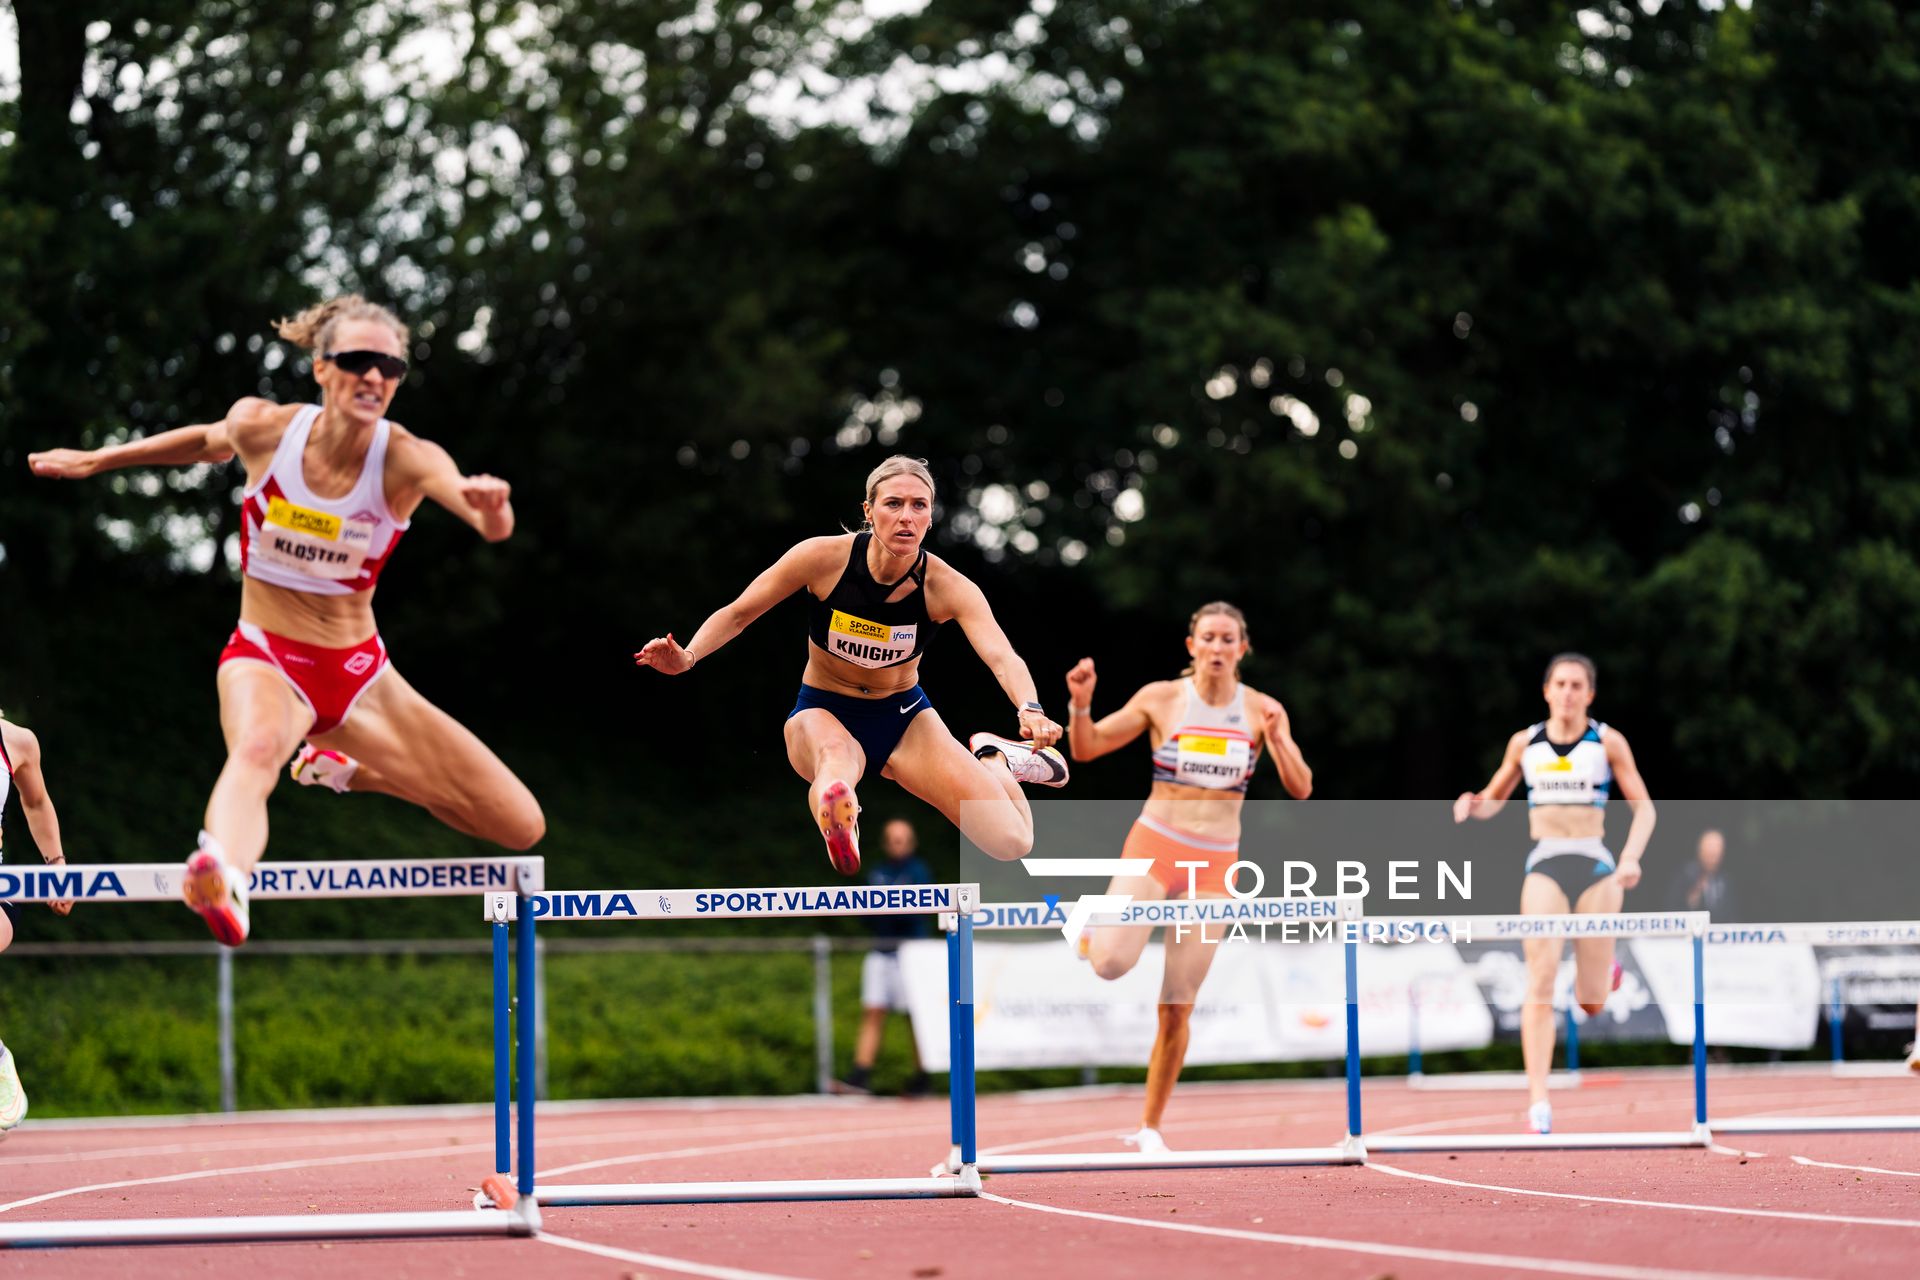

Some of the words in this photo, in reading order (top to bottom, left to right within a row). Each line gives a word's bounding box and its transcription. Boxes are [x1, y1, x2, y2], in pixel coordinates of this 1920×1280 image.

[274, 537, 349, 563] KLOSTER
[849, 628, 884, 639] VLAANDEREN
[893, 632, 914, 641] ifam
[836, 639, 905, 661] KNIGHT
[248, 863, 508, 892] RT.VLAANDEREN
[695, 888, 950, 913] SPORT.VLAANDEREN
[972, 906, 1067, 926] DIMA
[1120, 901, 1337, 922] SPORT.VLAANDEREN
[1708, 930, 1787, 943] DIMA
